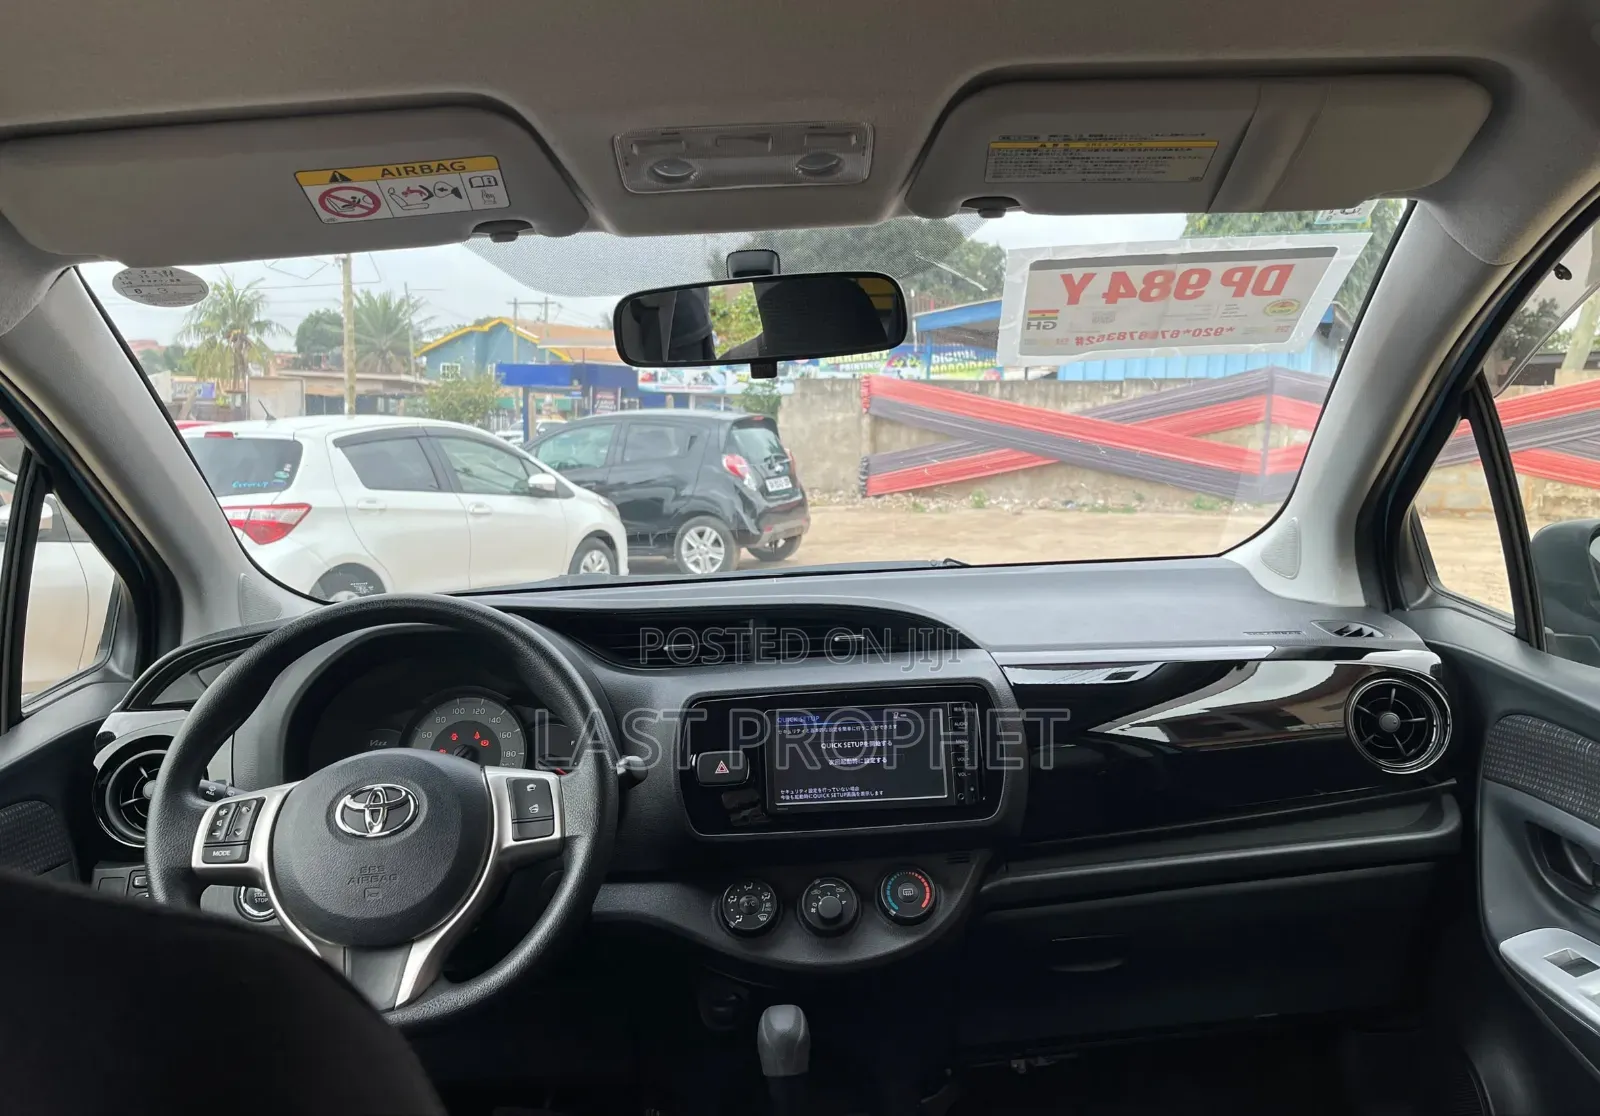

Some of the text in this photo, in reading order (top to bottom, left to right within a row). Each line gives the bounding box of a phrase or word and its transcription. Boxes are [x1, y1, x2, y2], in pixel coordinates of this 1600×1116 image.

[380, 161, 467, 178] AIRBAG
[839, 361, 880, 372] PRINTING
[452, 707, 466, 715] 100
[472, 707, 486, 715] 120
[435, 716, 447, 724] 80
[488, 716, 502, 724] 140
[776, 716, 798, 726] QUICK
[421, 731, 433, 739] 60
[499, 731, 512, 739] 160
[503, 750, 517, 758] 180
[347, 873, 398, 885] AIRBAG
